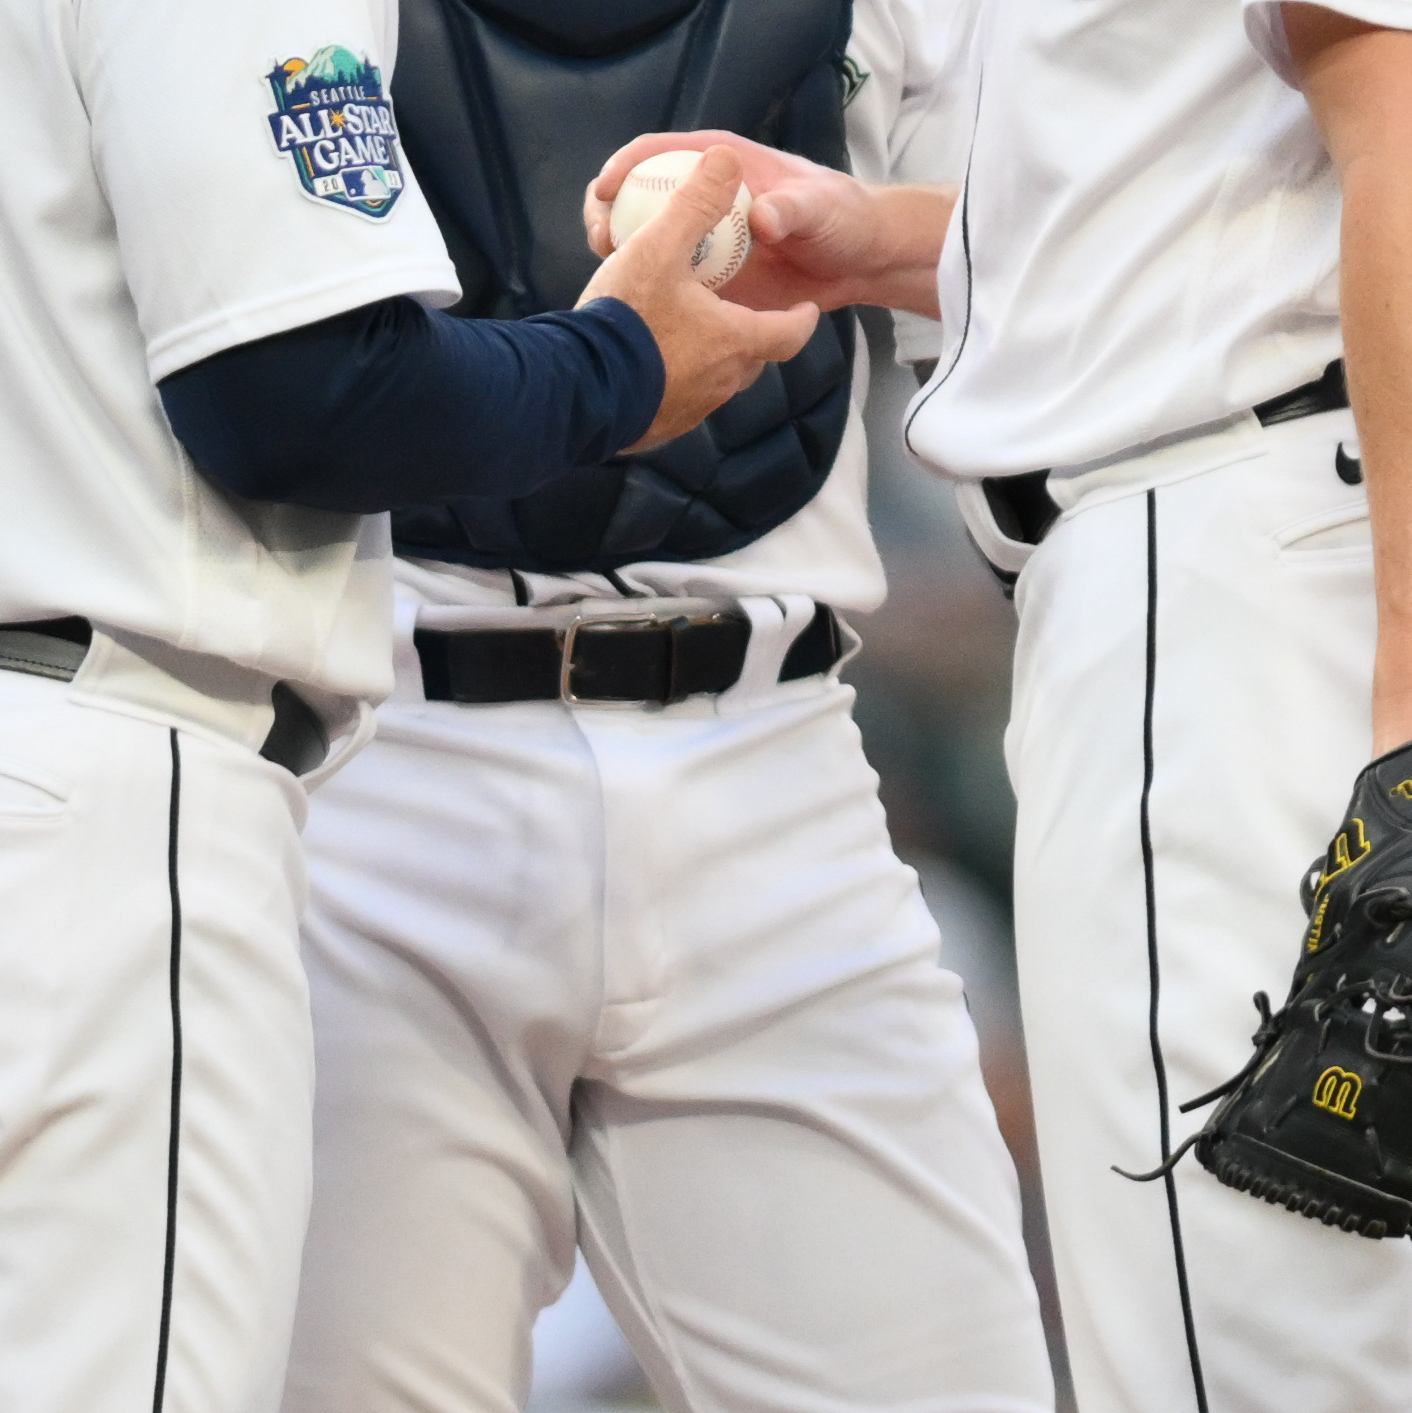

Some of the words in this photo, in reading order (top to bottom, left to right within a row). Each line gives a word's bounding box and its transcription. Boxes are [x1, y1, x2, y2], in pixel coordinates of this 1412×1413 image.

[309, 85, 366, 106] SEATTLE
[279, 109, 343, 148] ALL
[342, 103, 397, 135] STAR
[313, 135, 390, 170] GAME
